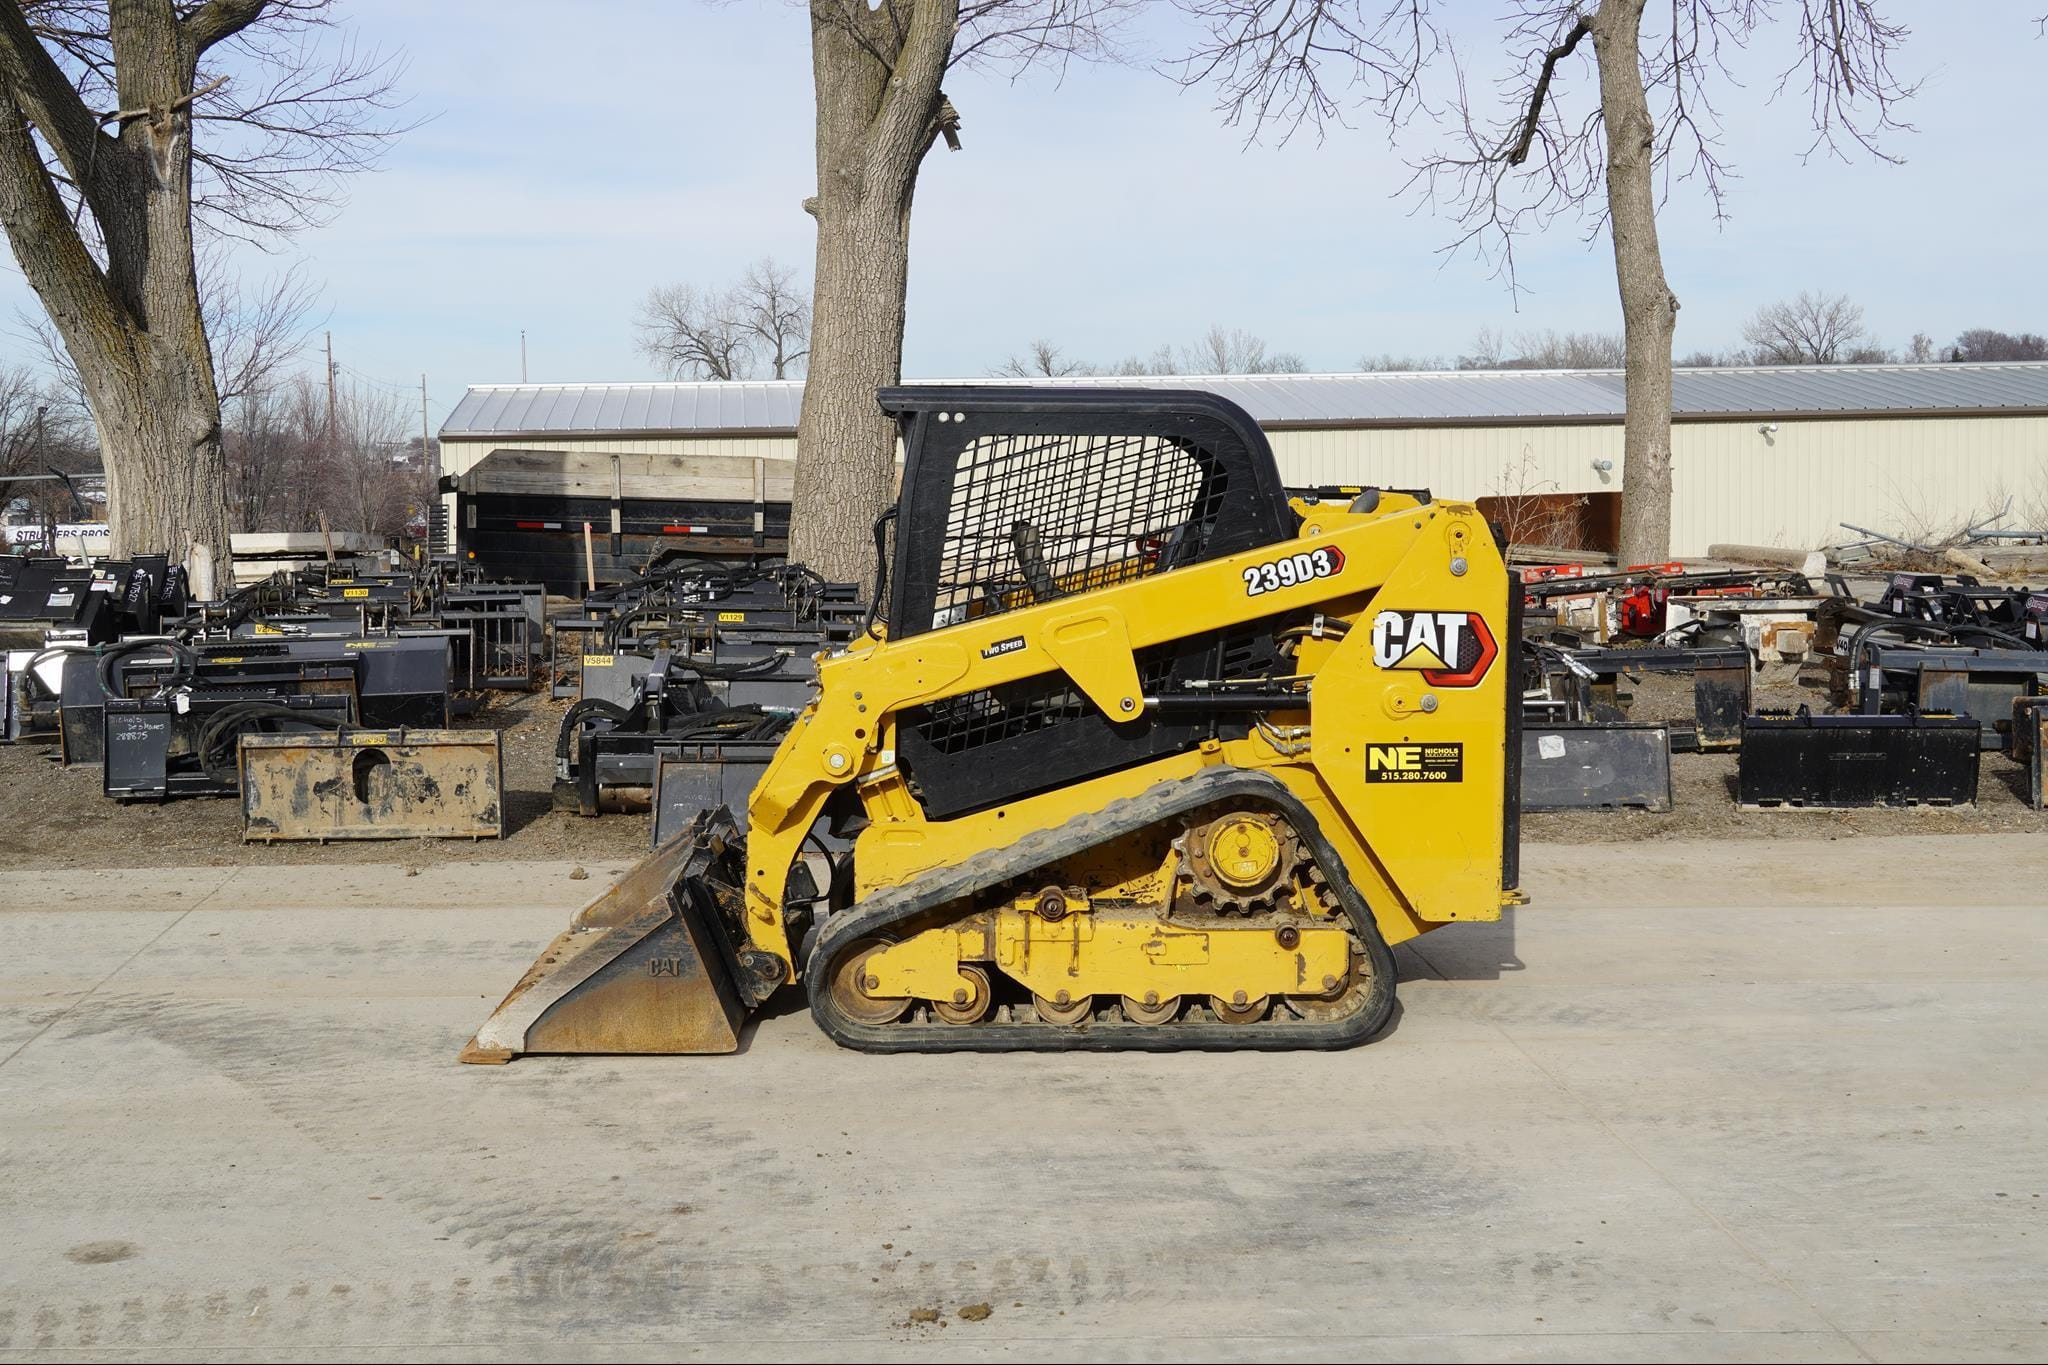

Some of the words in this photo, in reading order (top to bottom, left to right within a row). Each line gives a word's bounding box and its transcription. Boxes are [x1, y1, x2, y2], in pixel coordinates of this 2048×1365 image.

[1243, 548, 1332, 596] 239D3
[984, 646, 1000, 656] TWO
[1000, 639, 1023, 652] SPEED
[1373, 611, 1467, 669] CAT
[585, 656, 612, 665] V5844
[1369, 747, 1422, 770] NE
[1381, 771, 1447, 780] 515.280.7600
[649, 958, 681, 977] CAT
